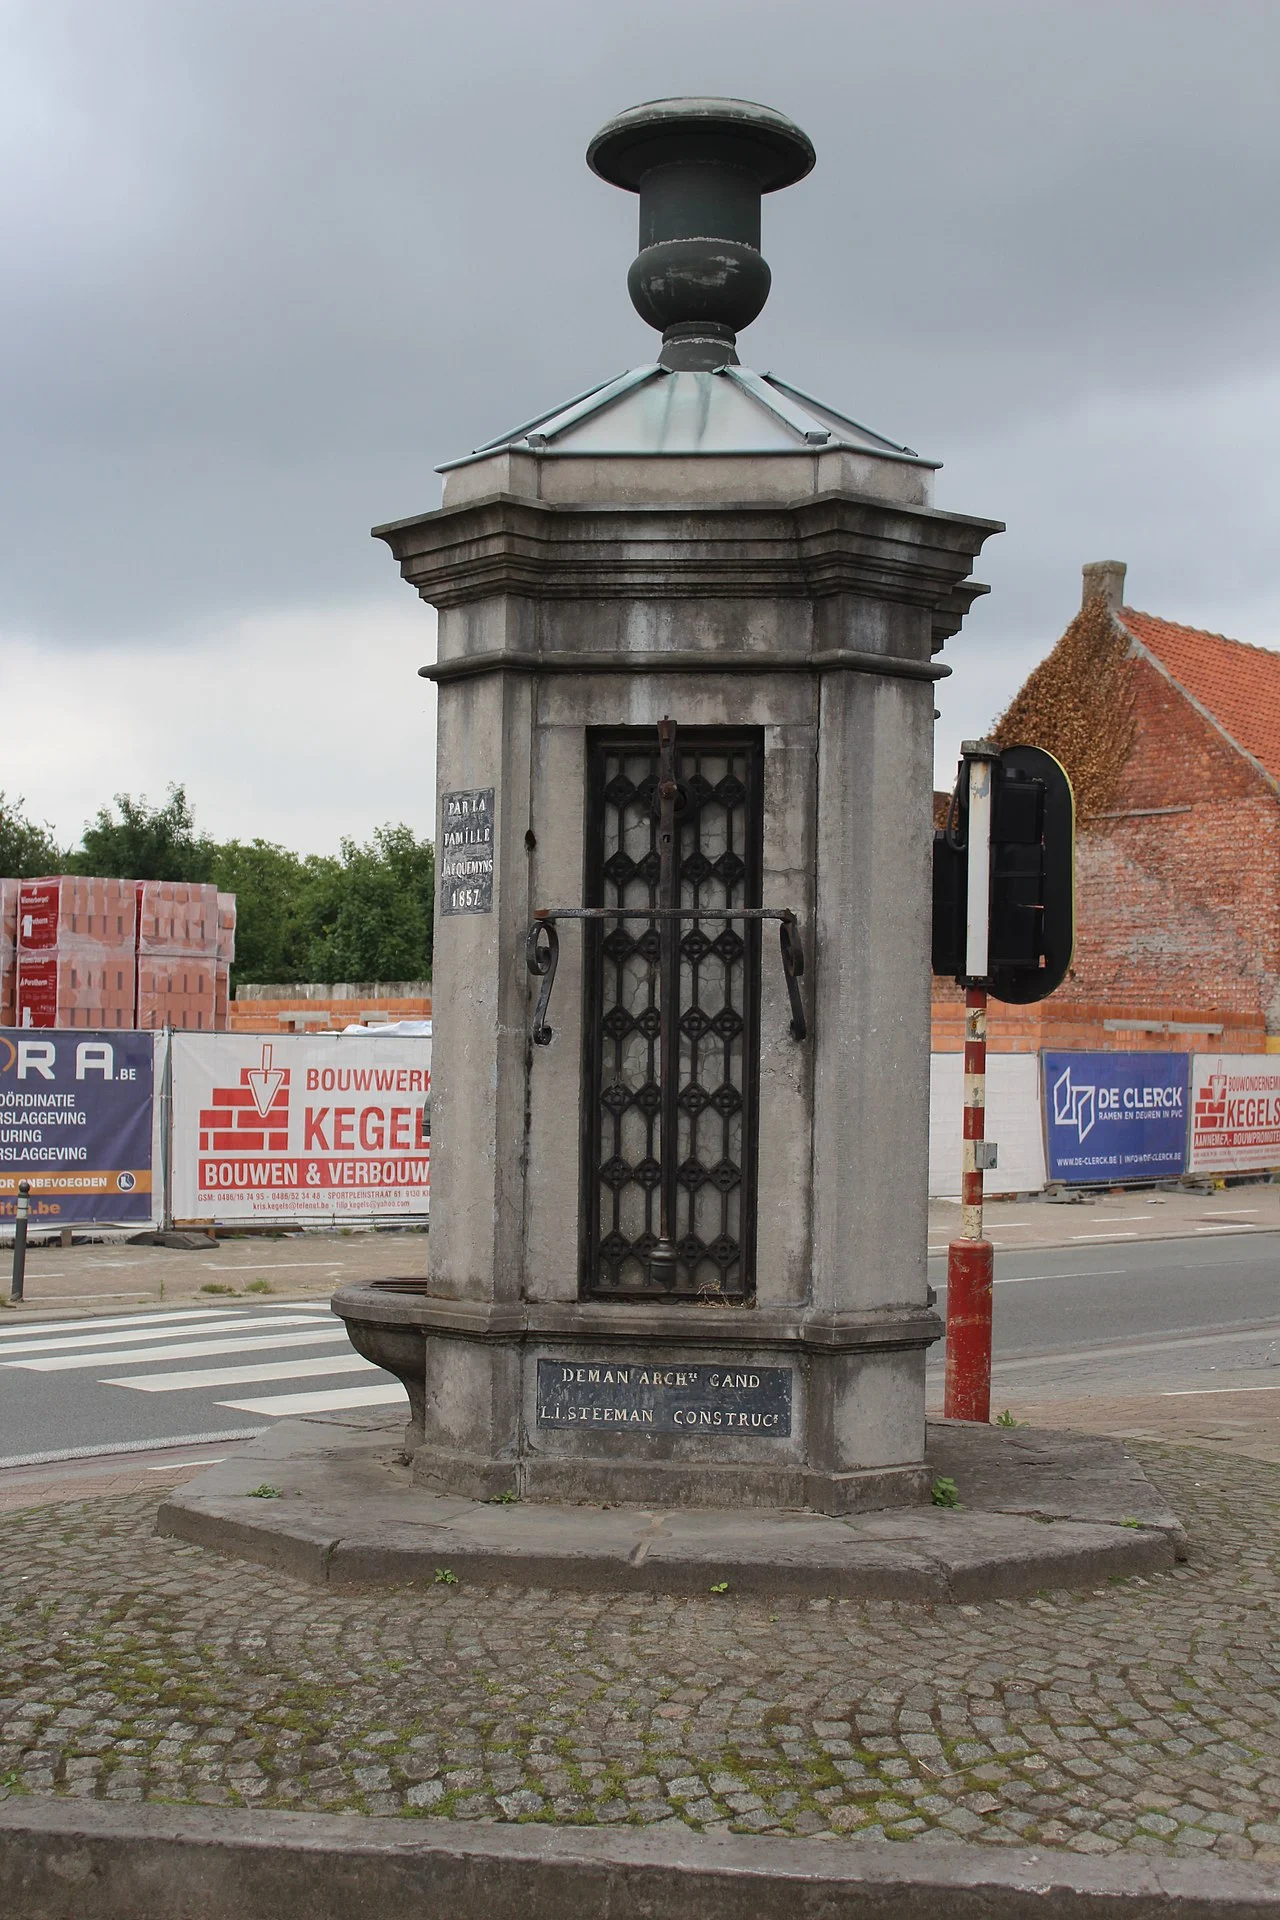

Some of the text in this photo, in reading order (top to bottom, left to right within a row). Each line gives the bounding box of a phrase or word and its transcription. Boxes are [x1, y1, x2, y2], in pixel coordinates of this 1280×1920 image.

[449, 799, 485, 815] PAR LA
[1098, 1087, 1182, 1109] DE CLERCK
[1099, 1109, 1183, 1120] RAMEN EN DEUREN IN PVC
[1226, 1097, 1280, 1128] KEGELS
[304, 1106, 431, 1151] KEGEL
[205, 1161, 430, 1186] BOUWEN & VERBOUW
[562, 1368, 628, 1384] DEMAN
[709, 1373, 760, 1388] GAND
